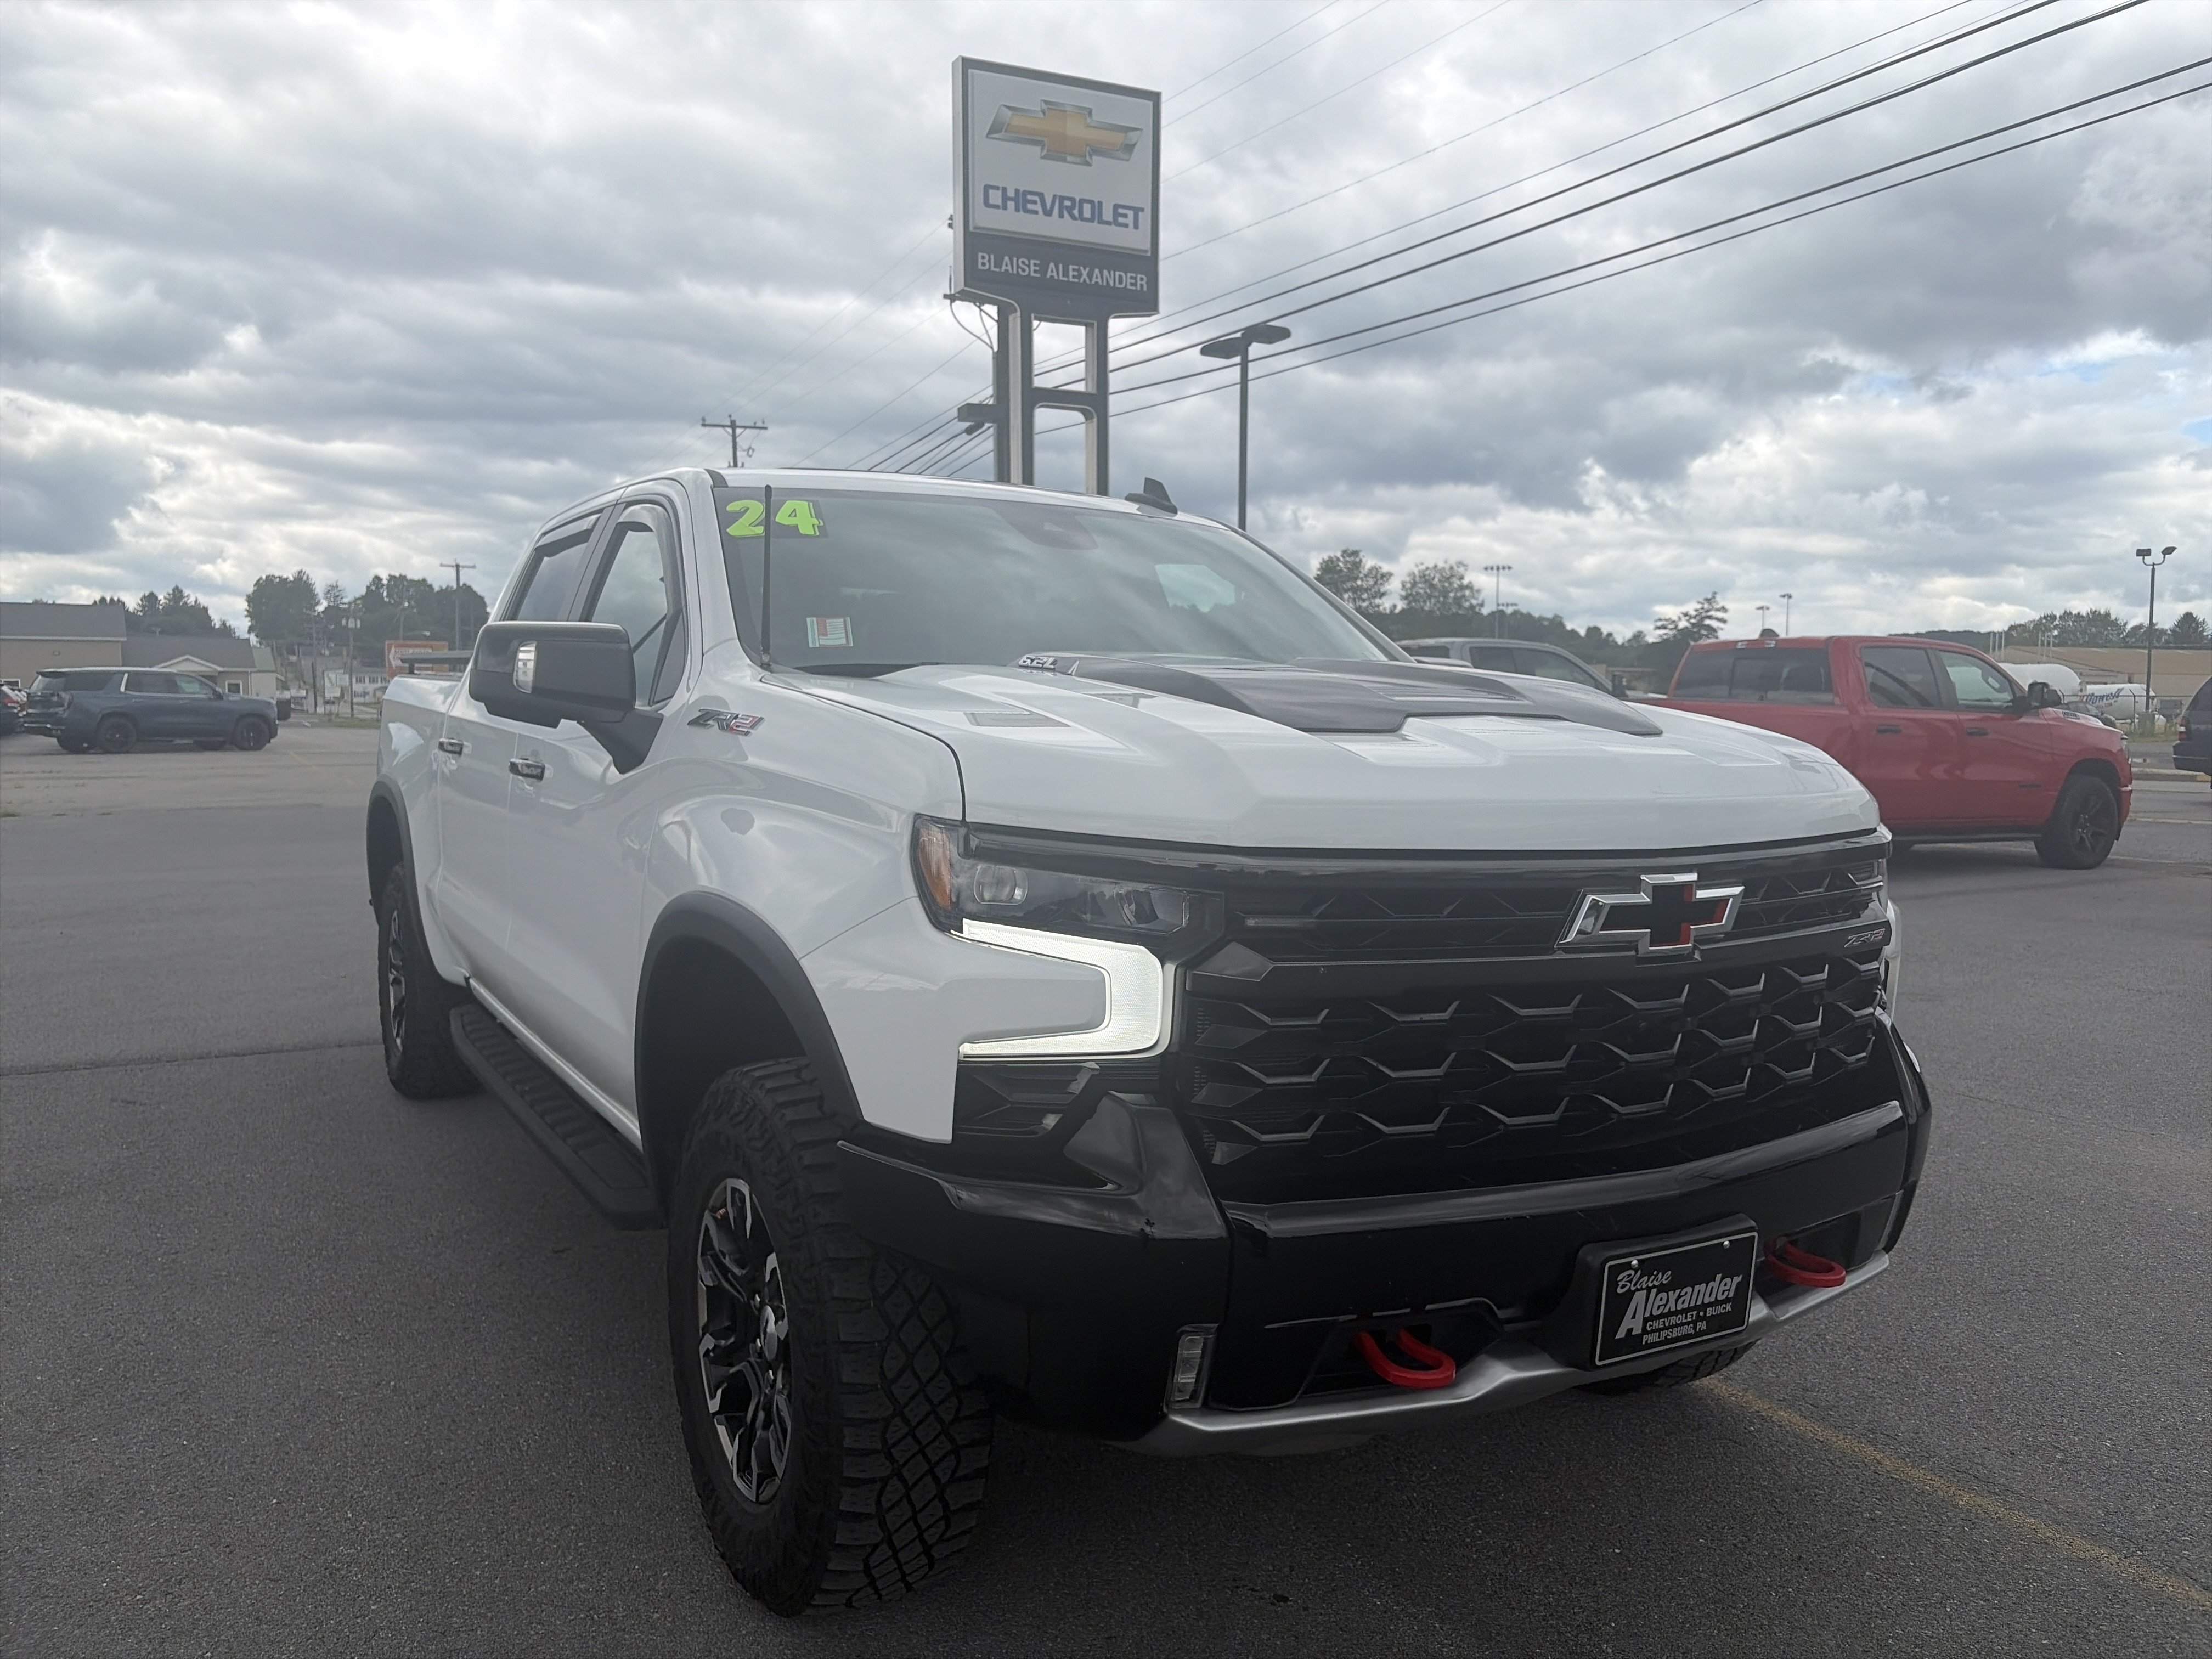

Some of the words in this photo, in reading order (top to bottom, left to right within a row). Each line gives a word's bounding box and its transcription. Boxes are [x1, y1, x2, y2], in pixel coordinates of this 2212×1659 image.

[983, 184, 1145, 230] CHEVROLET
[978, 252, 1041, 278] BLAISE
[1046, 262, 1148, 292] ALEXANDER
[726, 499, 824, 537] 24
[687, 707, 764, 736] ZR2
[1843, 928, 1886, 948] ZR2
[1616, 1269, 1672, 1294] Blaise
[1615, 1273, 1742, 1339] Alexander
[1646, 1311, 1697, 1331] CHEVROLET
[1706, 1302, 1733, 1317] BUICK
[1642, 1327, 1695, 1345] PHILIPSBURG,
[1696, 1320, 1707, 1332] PA
